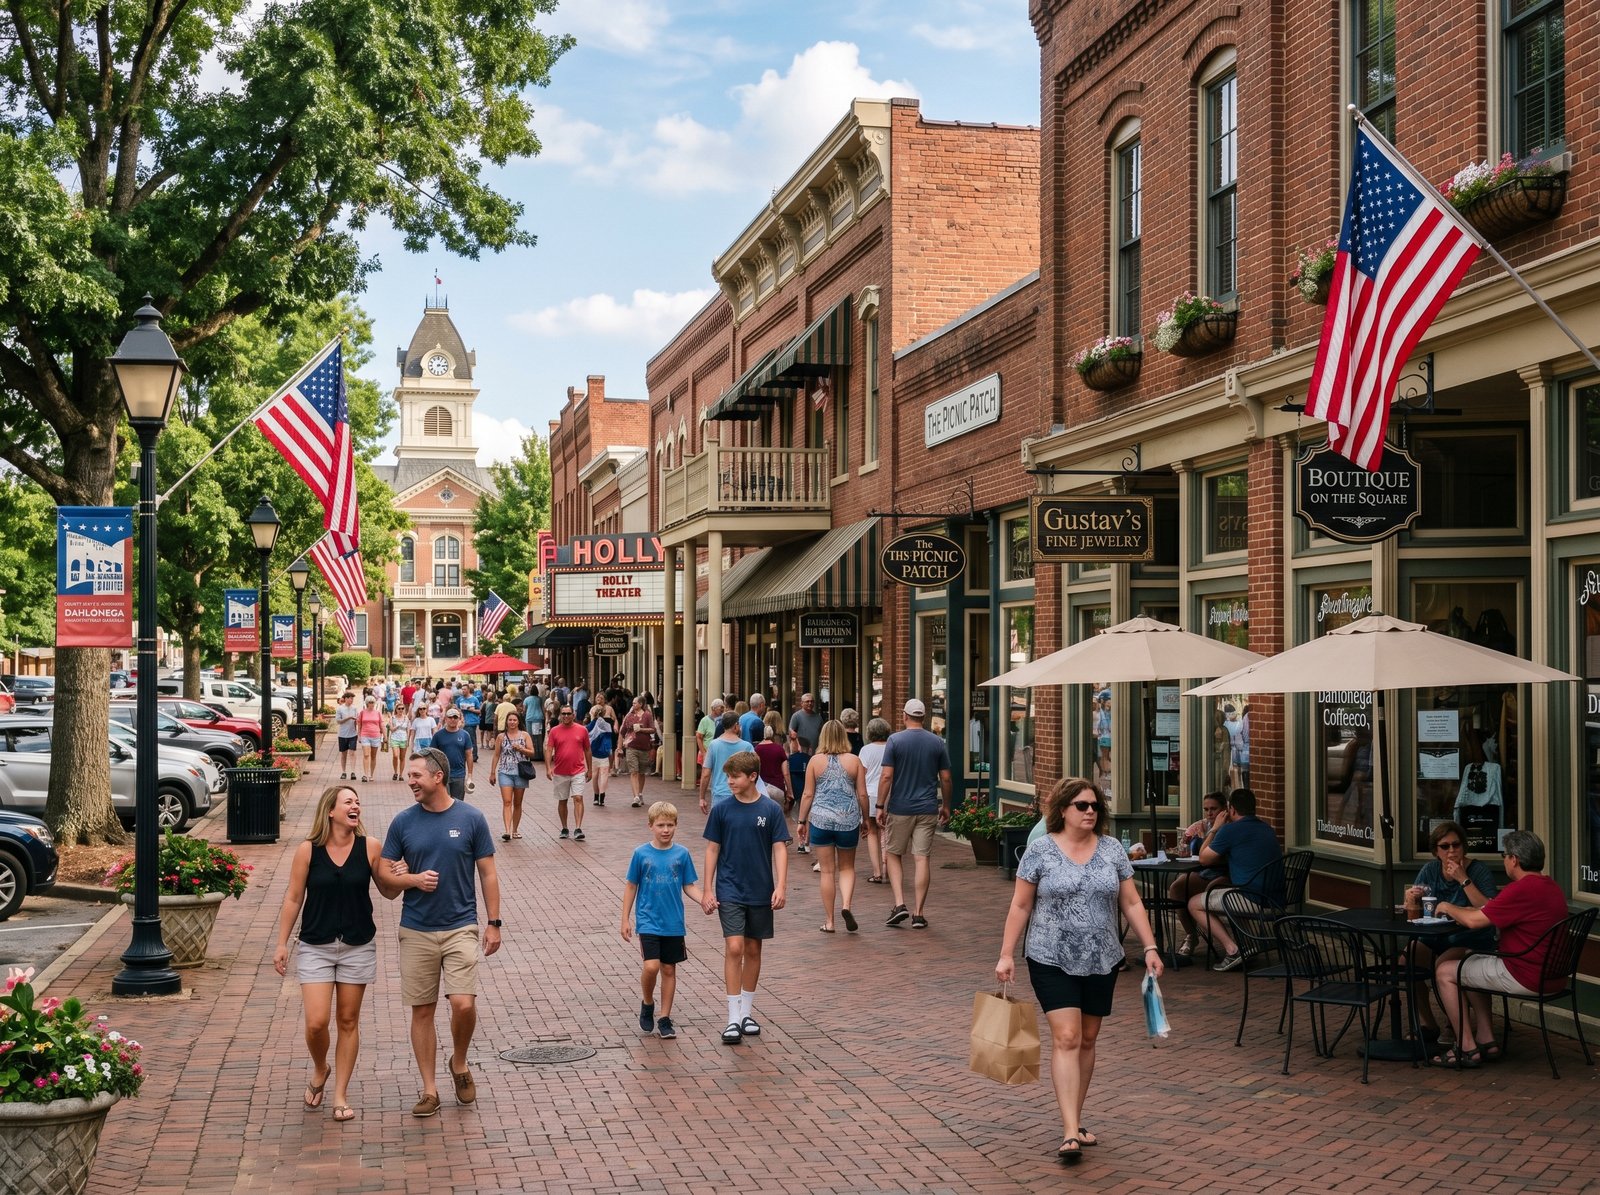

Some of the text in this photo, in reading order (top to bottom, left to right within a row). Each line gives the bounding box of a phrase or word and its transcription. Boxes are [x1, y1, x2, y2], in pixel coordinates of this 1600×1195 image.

[927, 387, 996, 438] THE PICNIC PATCH
[1308, 468, 1411, 491] BOUTIQUE
[1310, 492, 1408, 506] ON THE SQUARE
[1043, 507, 1142, 531] Gustav's
[915, 539, 933, 549] The
[1045, 535, 1142, 550] FINE JEWELRY
[912, 550, 958, 563] PICNIC
[901, 565, 949, 578] PATCH
[602, 575, 633, 586] ROLLY
[595, 587, 642, 598] THEATER
[64, 608, 125, 617] DAHLONEGA
[1580, 865, 1599, 881] The
